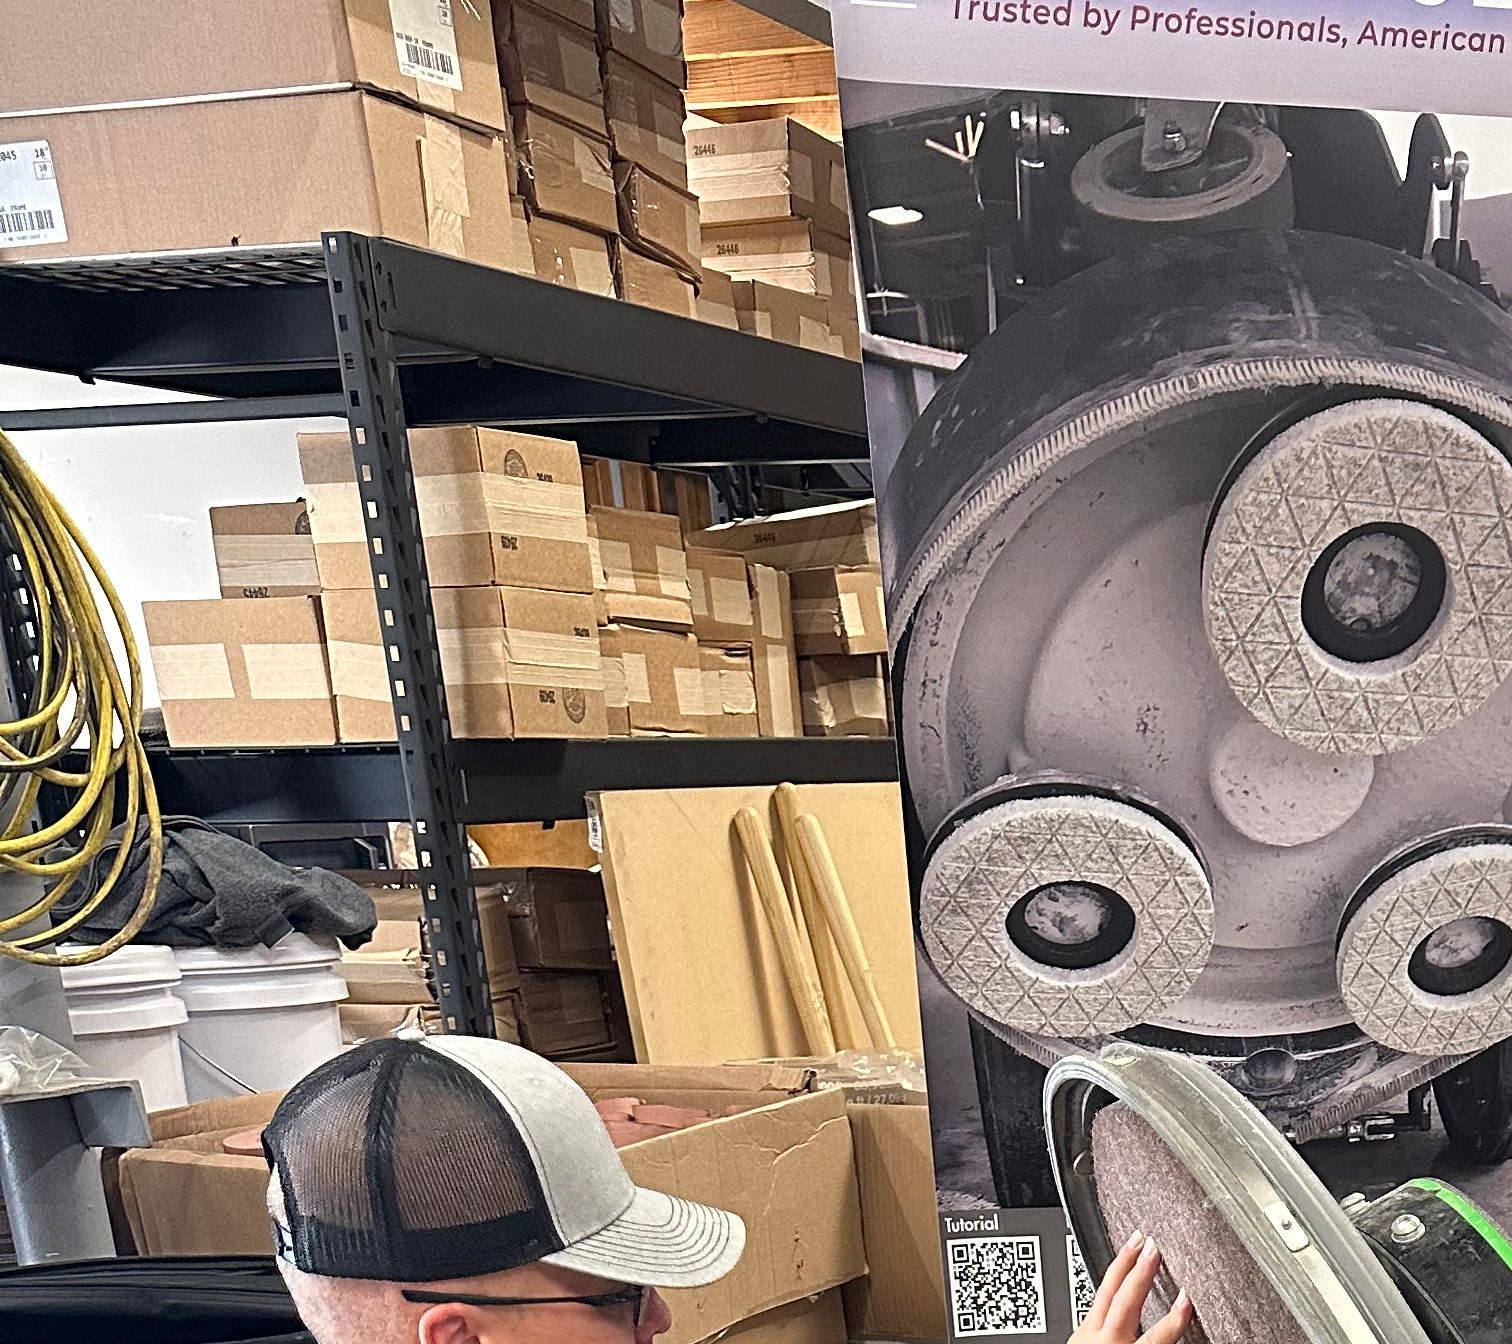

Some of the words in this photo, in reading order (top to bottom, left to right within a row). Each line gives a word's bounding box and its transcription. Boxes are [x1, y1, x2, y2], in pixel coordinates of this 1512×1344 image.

[1082, 0, 1121, 35] by
[1129, 4, 1349, 48] Professionals,
[1357, 20, 1506, 54] American
[944, 1213, 999, 1233] Tutorial
